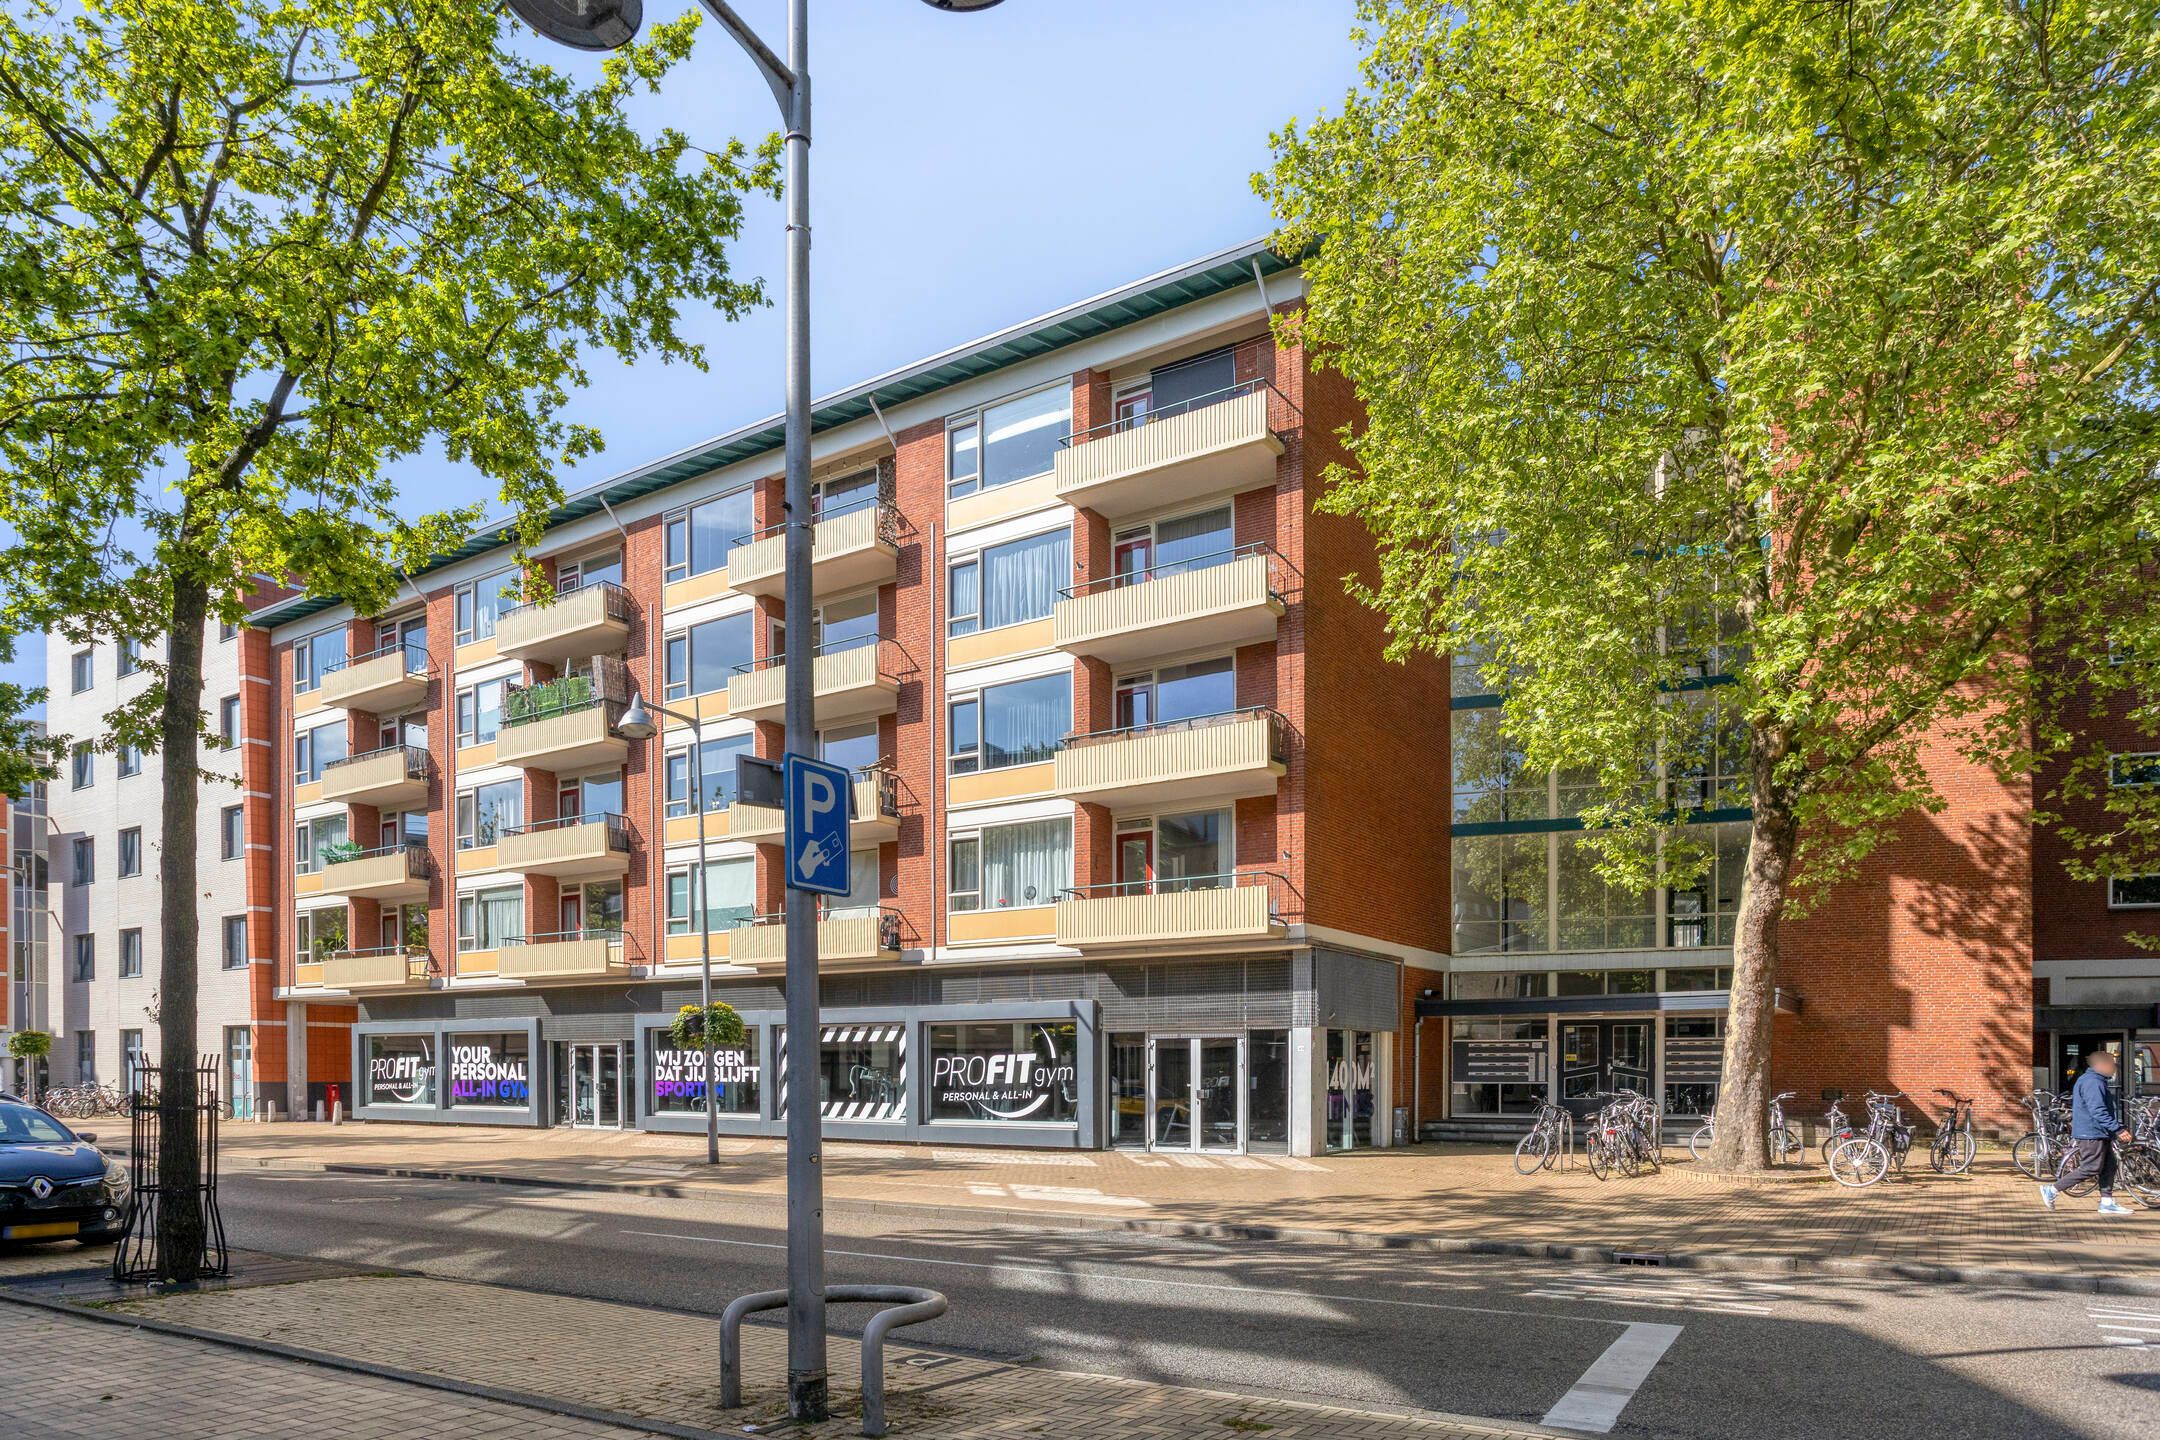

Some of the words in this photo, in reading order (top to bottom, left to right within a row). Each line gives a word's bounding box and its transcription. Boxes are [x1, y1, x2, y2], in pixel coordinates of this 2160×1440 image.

[804, 770, 835, 833] P
[451, 1046, 491, 1063] YOUR
[655, 1050, 681, 1066] WIJ
[683, 1050, 745, 1067] ZOGEN
[369, 1056, 421, 1080] PROFIT
[418, 1066, 436, 1081] gym
[451, 1063, 527, 1080] PERSONAL
[655, 1065, 682, 1081] DAT
[684, 1066, 706, 1082] JIJ
[933, 1053, 1037, 1087] PROFIT
[1034, 1066, 1074, 1087] gym
[374, 1083, 398, 1091] PERSONAL
[451, 1080, 497, 1097] ALL-IN
[499, 1080, 529, 1098] GYM
[655, 1081, 725, 1097] SPORTN
[942, 1091, 990, 1102] PERSONAL
[992, 1091, 999, 1100] &
[1001, 1090, 1033, 1100] ALL-IN
